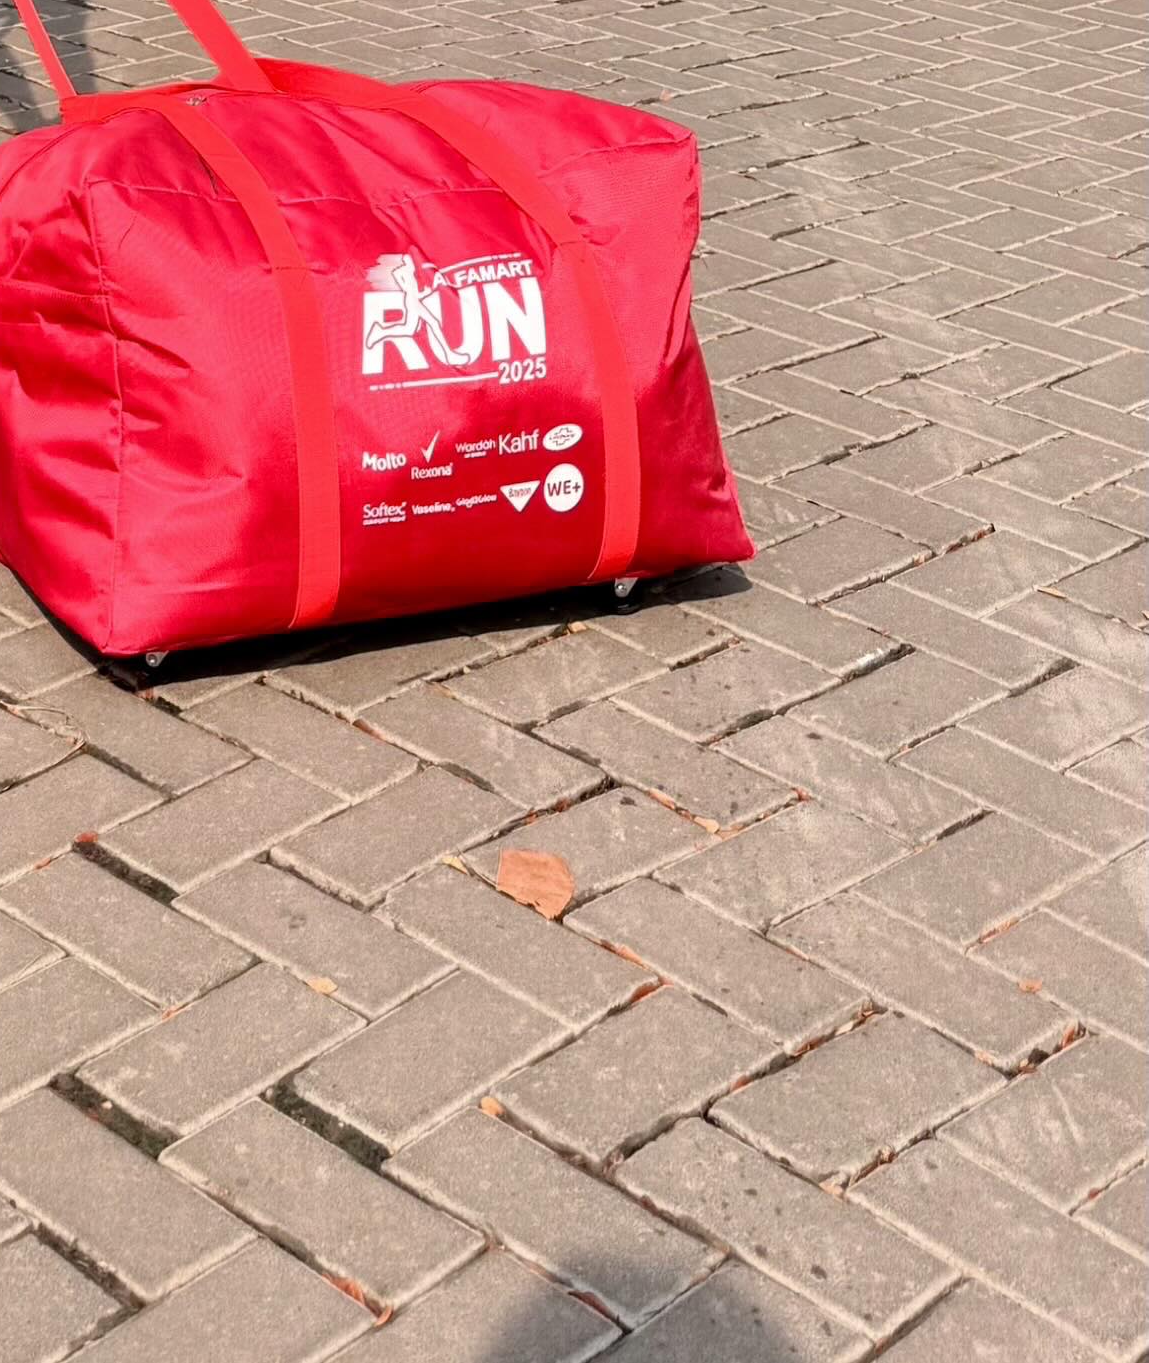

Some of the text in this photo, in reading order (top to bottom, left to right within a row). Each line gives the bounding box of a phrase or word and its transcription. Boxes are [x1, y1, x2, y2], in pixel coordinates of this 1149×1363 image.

[362, 277, 547, 375] RUN
[499, 357, 547, 385] 2025
[498, 428, 540, 455] Kahf
[362, 451, 407, 472] Molto
[411, 464, 452, 480] Rexona
[547, 480, 581, 497] WE+
[362, 502, 406, 519] Softex
